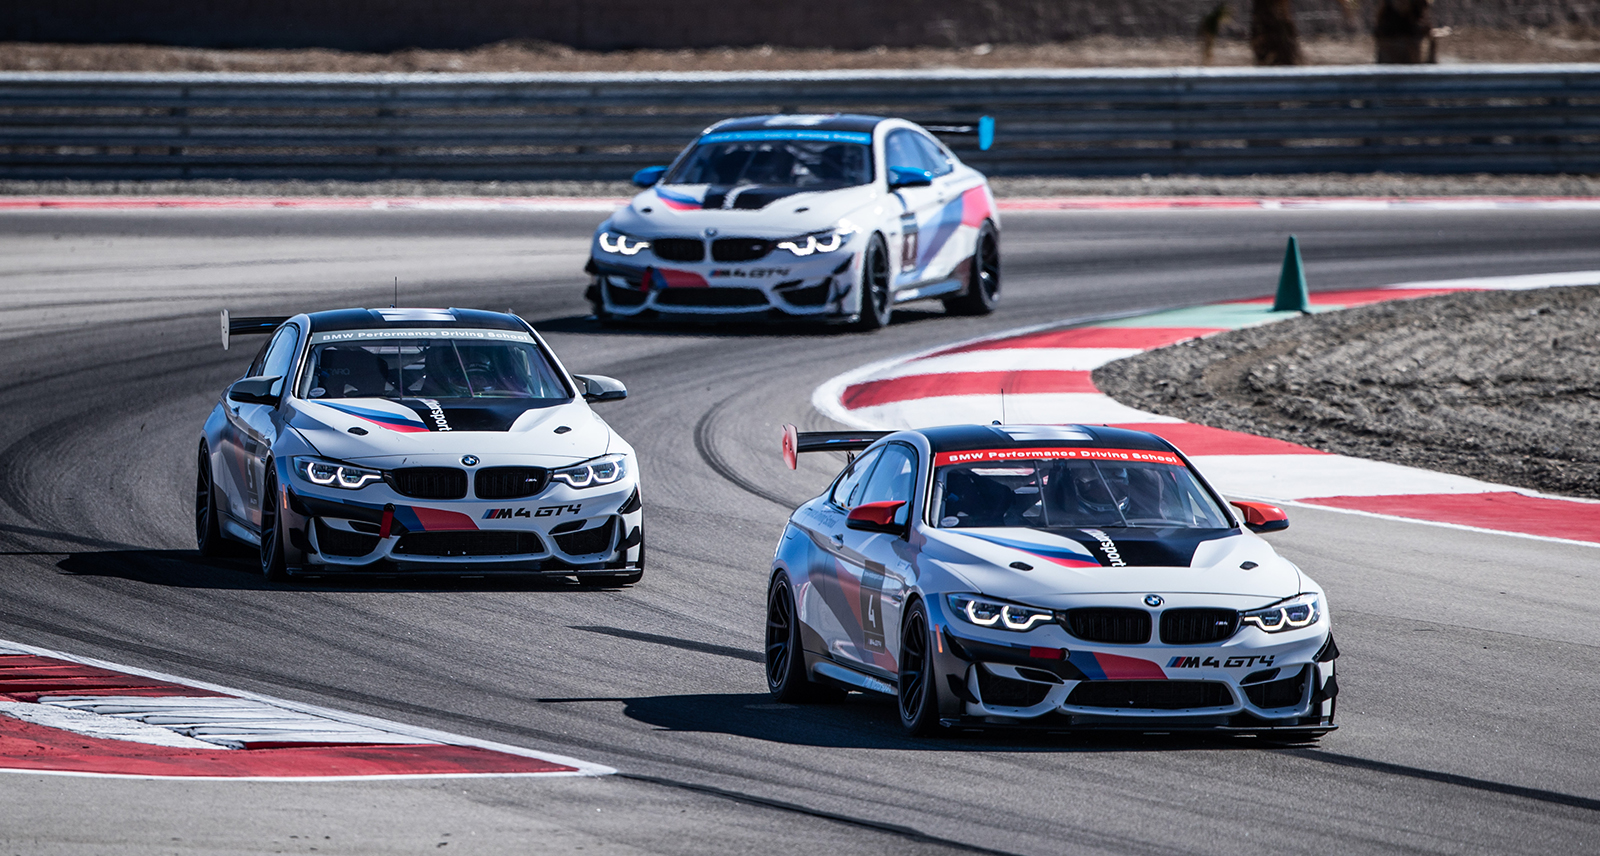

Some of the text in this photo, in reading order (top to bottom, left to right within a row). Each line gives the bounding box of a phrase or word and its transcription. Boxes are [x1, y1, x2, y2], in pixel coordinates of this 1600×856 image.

[323, 333, 354, 341] BMW
[441, 330, 484, 338] Driving
[487, 332, 528, 341] School
[949, 450, 1178, 463] BMW Performance Driving School
[495, 503, 582, 519] M4 GT4
[868, 594, 876, 629] 4
[1180, 654, 1275, 668] M4 GT4
